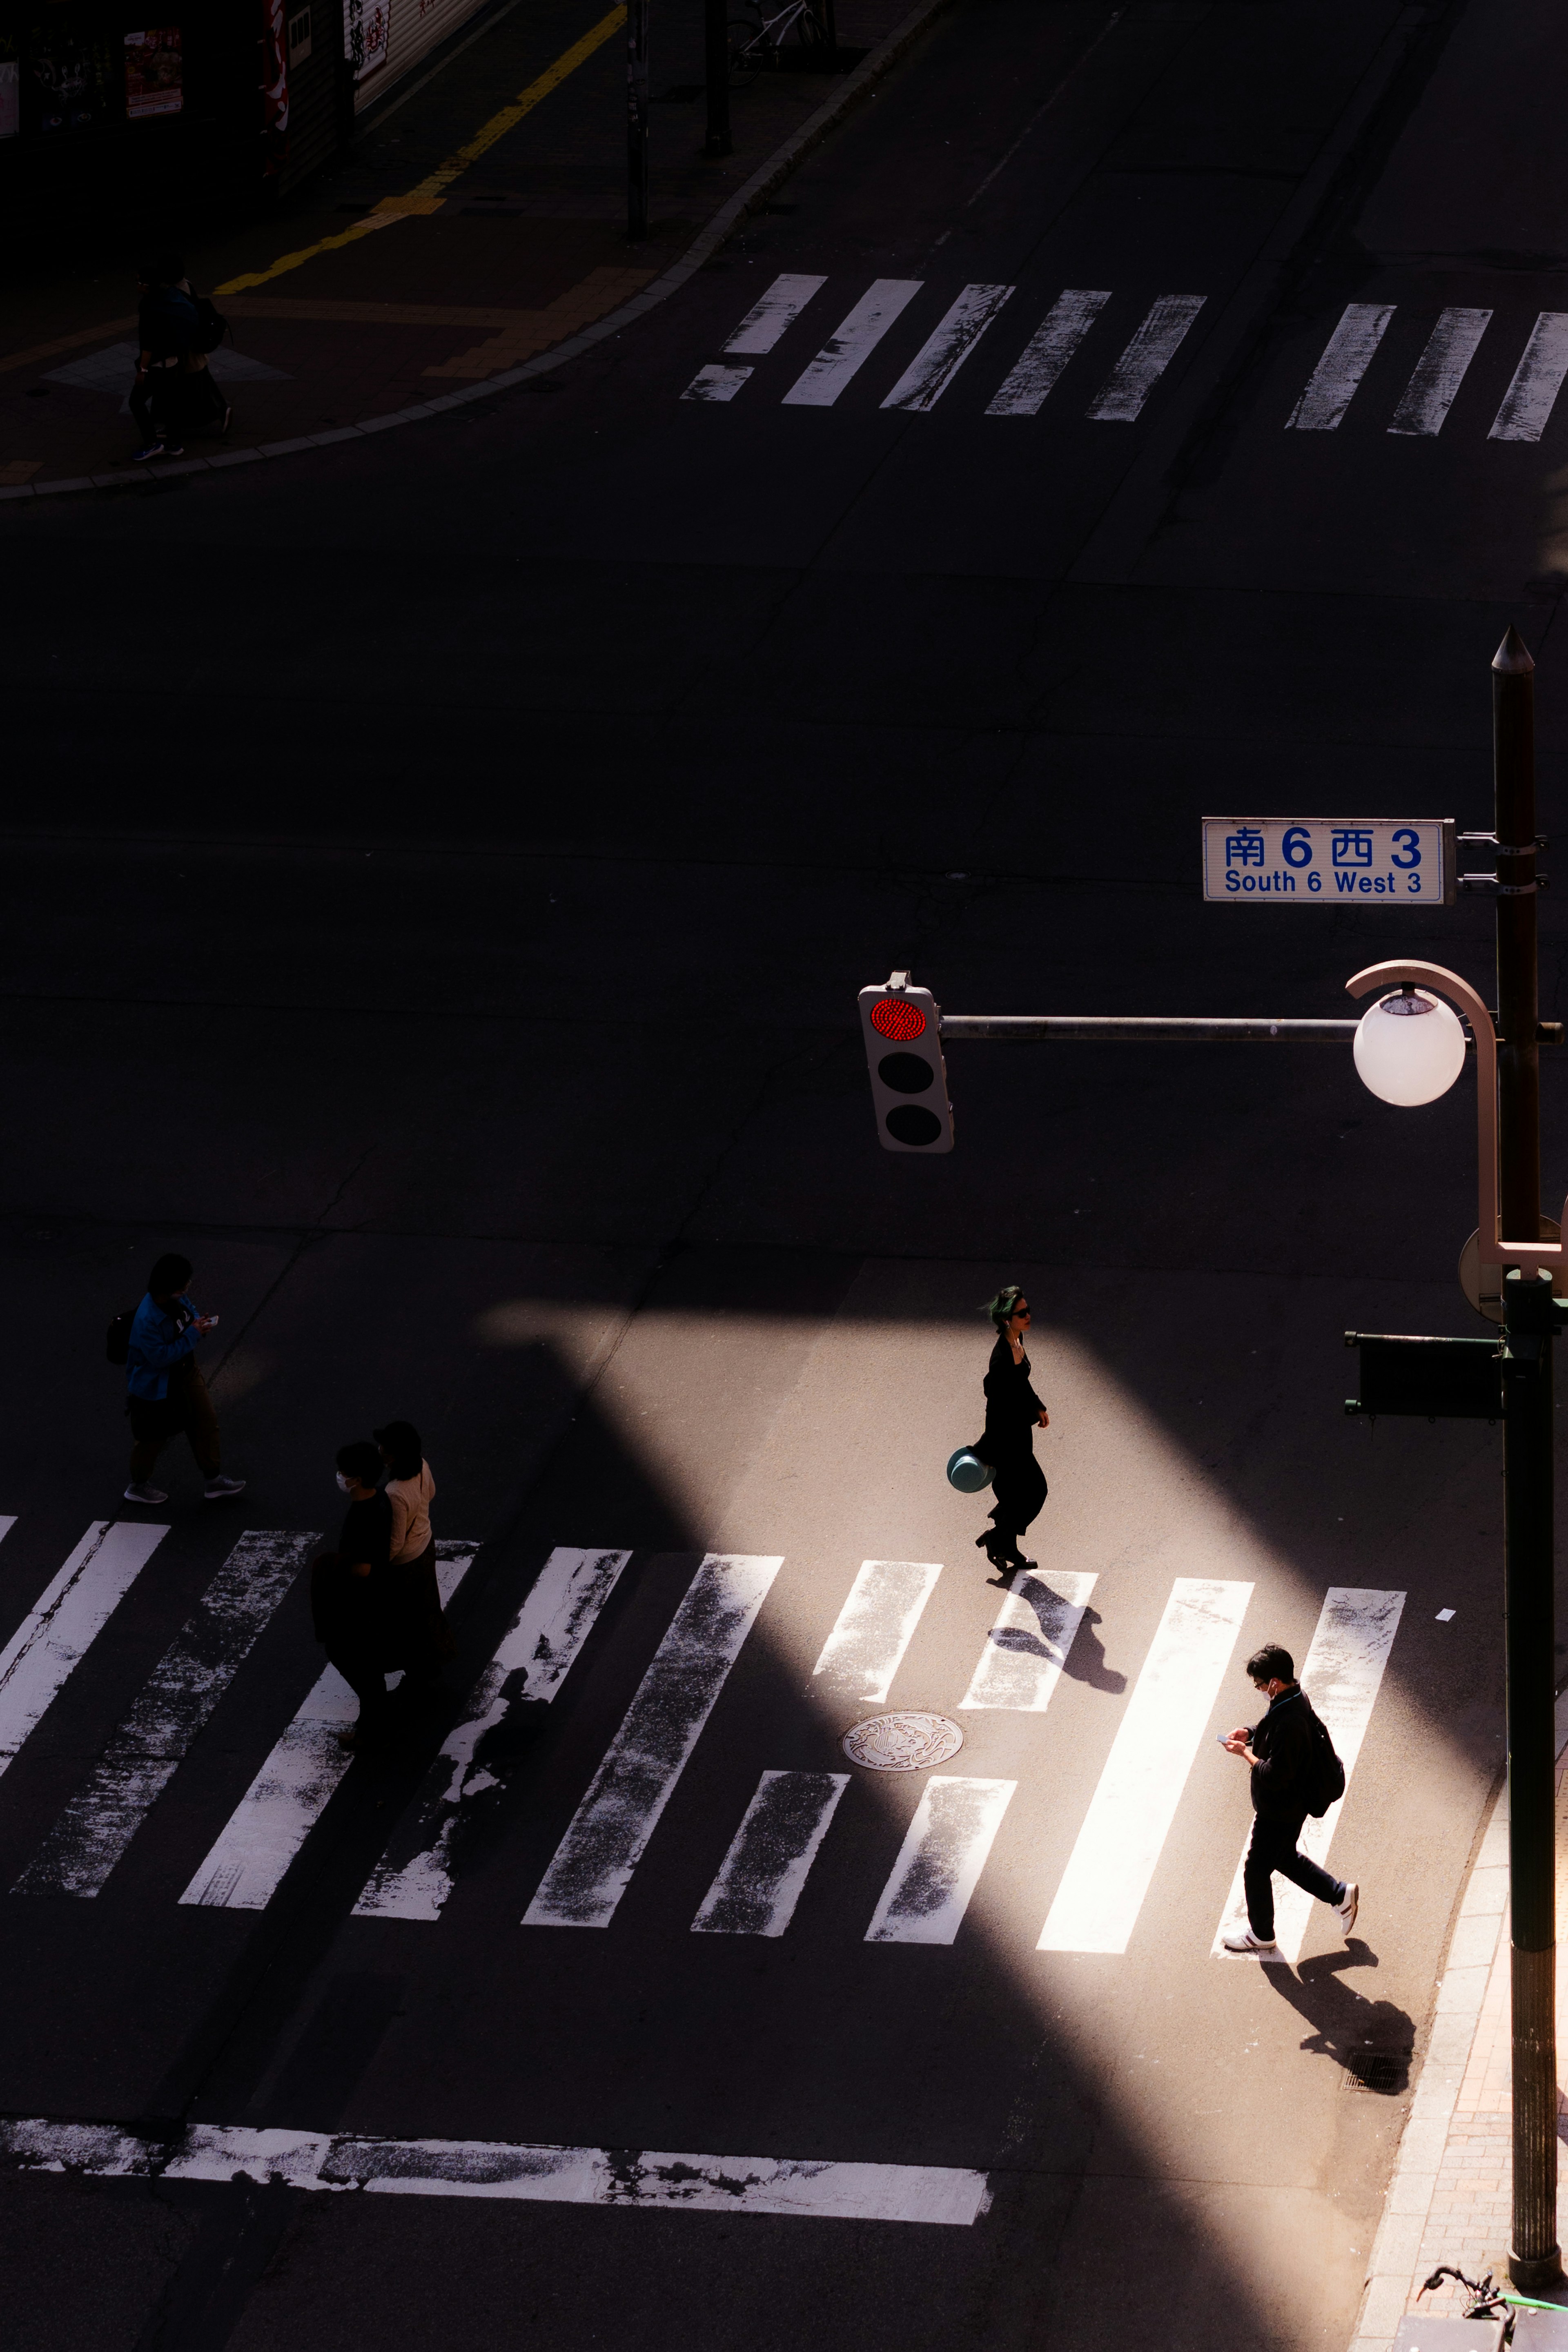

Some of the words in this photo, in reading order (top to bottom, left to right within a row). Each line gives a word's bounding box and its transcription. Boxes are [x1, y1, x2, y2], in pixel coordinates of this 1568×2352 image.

[1225, 870, 1295, 892] South
[1307, 871, 1322, 892] 6
[1334, 872, 1395, 893] West
[1408, 873, 1421, 893] 3
